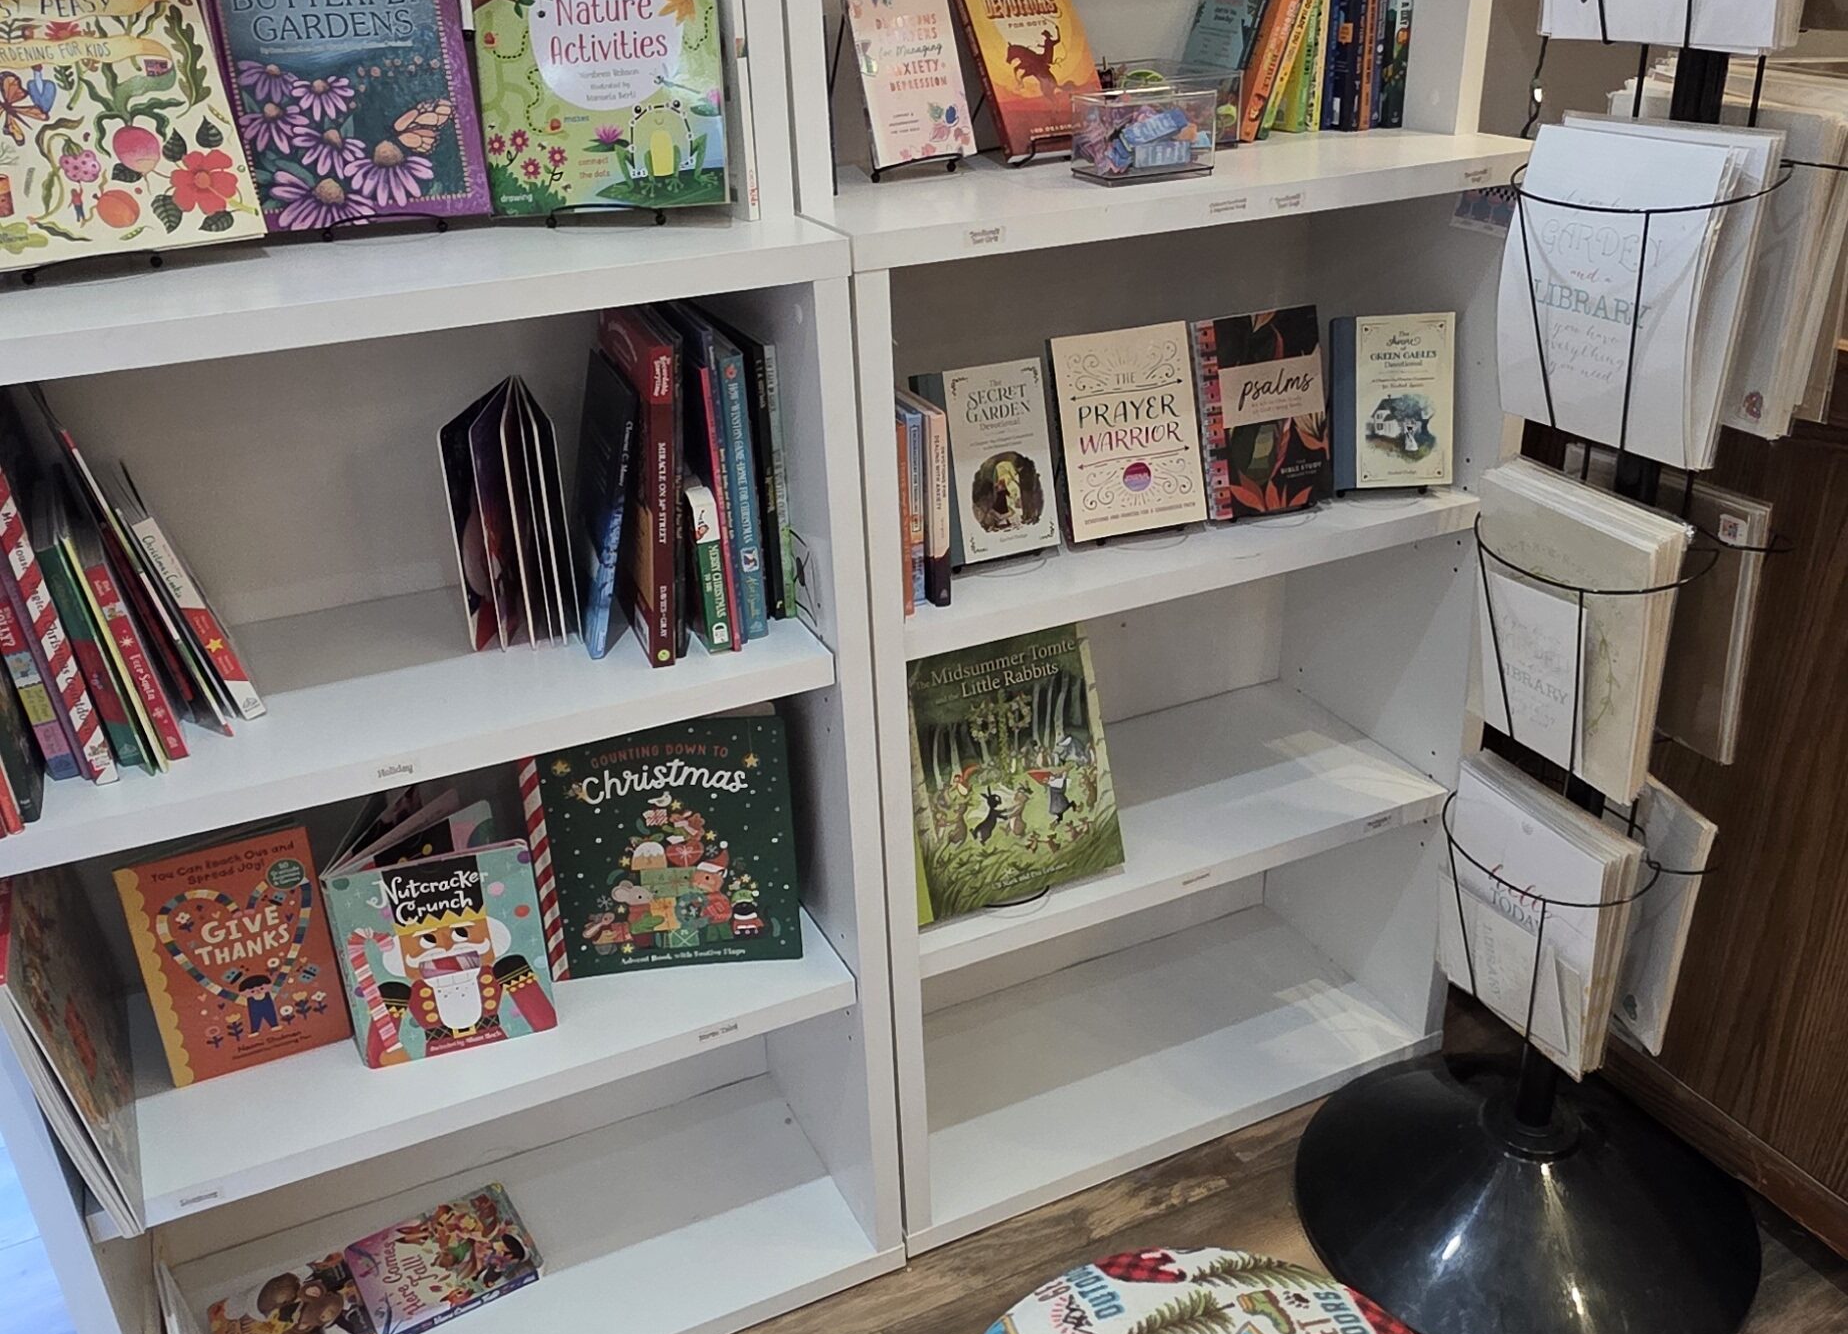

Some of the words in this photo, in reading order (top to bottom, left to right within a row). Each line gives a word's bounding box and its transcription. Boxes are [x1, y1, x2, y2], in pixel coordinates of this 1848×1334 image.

[253, 9, 413, 42] GARDENS
[551, 30, 668, 65] Activities
[890, 77, 948, 92] DEPRESSION
[500, 193, 533, 204] drawing
[1541, 219, 1663, 272] GARDEN
[1533, 278, 1652, 329] LIBRARY
[1554, 321, 1581, 338] you
[1586, 323, 1618, 344] have
[1370, 352, 1401, 361] GREEN
[1403, 350, 1437, 360] GABLES
[1384, 360, 1423, 368] Devotional
[1544, 339, 1624, 368] everything
[1115, 373, 1135, 385] THE
[1549, 359, 1574, 375] you
[1580, 369, 1613, 381] need
[967, 384, 1027, 411] SECRET
[1238, 368, 1315, 411] psalms
[966, 400, 1031, 424] GARDEN
[980, 418, 1020, 431] Devotional
[1078, 393, 1180, 429] PRAYER
[1080, 421, 1183, 455] WARRIOR
[657, 442, 665, 482] MIRACLE
[658, 483, 665, 497] ON
[658, 512, 666, 544] STREET
[141, 532, 174, 576] Christmas
[165, 572, 187, 599] Cookie
[707, 544, 721, 573] MERRY
[710, 572, 727, 618] CHRISTMAS
[916, 680, 930, 691] The
[930, 650, 1025, 687] Midsummer
[1029, 639, 1076, 661] Tomte
[376, 762, 415, 778] Holiday
[589, 742, 660, 769] COUNTING
[664, 742, 708, 757] DOWN
[711, 744, 730, 758] TO
[579, 758, 749, 806] Christmas
[151, 872, 174, 883] You
[176, 865, 201, 878] Can
[205, 854, 242, 869] Reach
[244, 849, 269, 860] Out
[271, 841, 295, 853] and
[187, 868, 234, 885] Spread
[237, 858, 266, 873] Joy!
[365, 869, 489, 910] Nutcracker
[201, 905, 280, 944] GIVE
[394, 894, 474, 926] Crunch
[194, 923, 291, 965] THANKS
[620, 954, 650, 966] Advent
[650, 953, 673, 963] Book
[674, 952, 691, 961] with
[383, 1240, 402, 1285] Comes
[398, 1286, 427, 1316] Here
